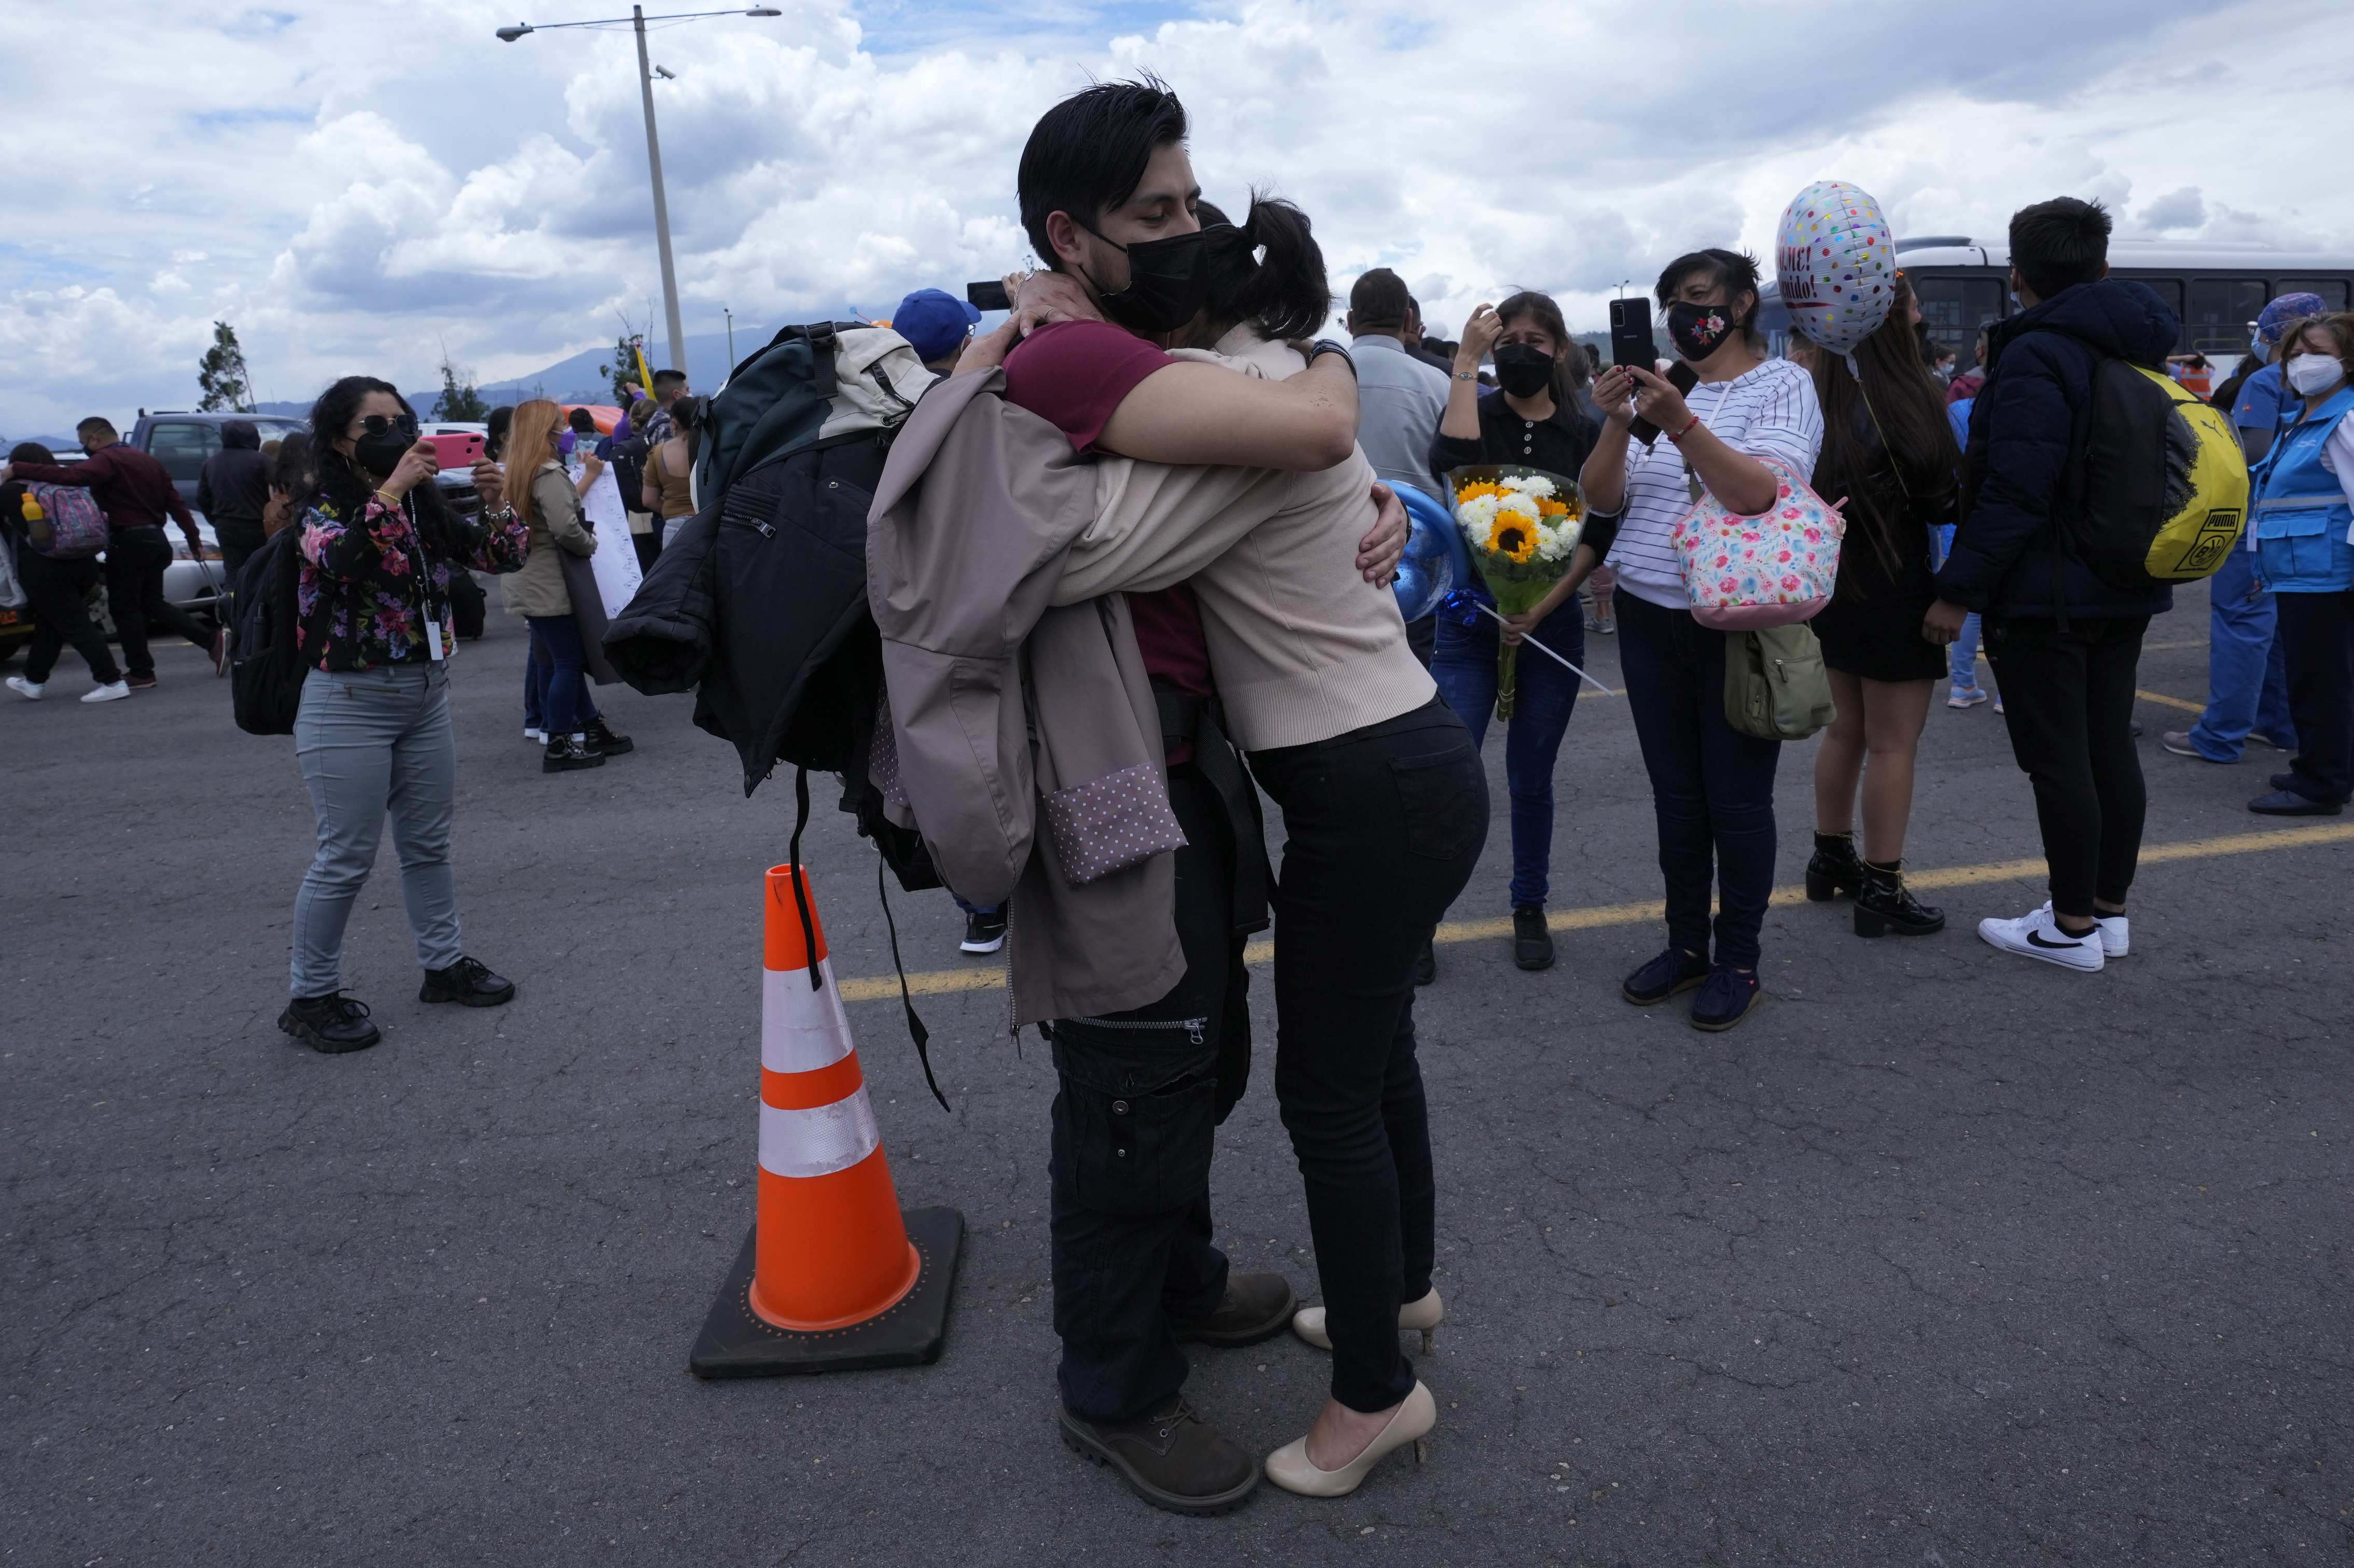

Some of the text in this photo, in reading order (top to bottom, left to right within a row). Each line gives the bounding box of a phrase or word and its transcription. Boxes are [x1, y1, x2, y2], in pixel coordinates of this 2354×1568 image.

[1778, 245, 1811, 271] OME!
[1779, 274, 1817, 299] enido!
[2207, 514, 2236, 527] PUMA
